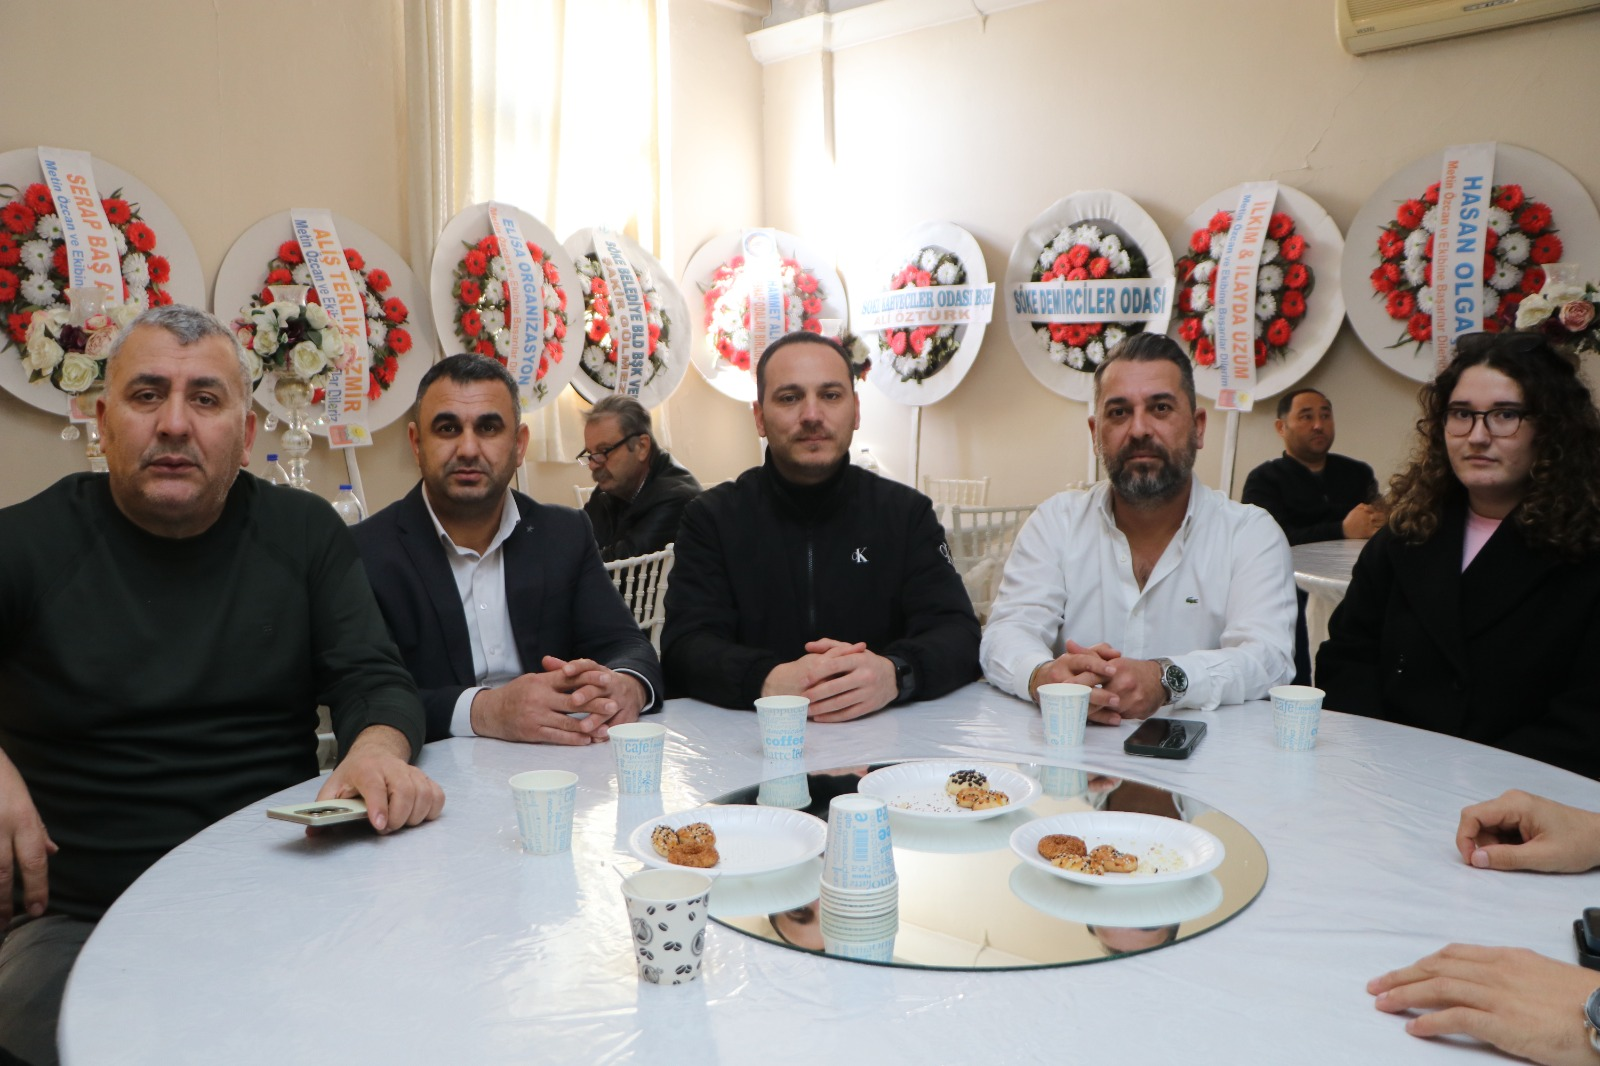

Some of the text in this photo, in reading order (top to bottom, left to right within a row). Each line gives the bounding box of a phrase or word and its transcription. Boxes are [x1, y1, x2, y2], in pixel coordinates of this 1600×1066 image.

[1447, 160, 1459, 189] Metin
[45, 160, 84, 288] Metin Özcan ve Ekibin
[67, 173, 103, 231] SERAP
[87, 234, 112, 275] BAŞ
[489, 206, 500, 234] Metin
[1237, 194, 1251, 222] Metin
[1441, 191, 1454, 225] Özcan
[498, 236, 510, 266] Özcan
[1226, 223, 1243, 256] Özcan
[1441, 228, 1448, 240] ve
[294, 219, 312, 248] Metin
[306, 248, 324, 282] Özcan
[319, 282, 329, 295] ve
[506, 267, 513, 279] ve
[1222, 256, 1229, 267] ve
[1437, 242, 1449, 283] Ekibine
[1451, 175, 1484, 344] HASAN OLGA
[313, 228, 341, 267] ALİŞ
[330, 268, 360, 337] TERLİK
[509, 280, 521, 315] Ekibine
[618, 267, 643, 322] BELEDİYE
[937, 289, 974, 308] ODASI
[1013, 281, 1167, 315] SÖKE DEMİRCİLER ODASI
[1219, 269, 1231, 306] Ekibine
[1231, 200, 1265, 379] İLKİM & İLAYDA ÜZÜM
[502, 218, 542, 386] ELİSA ORGANİZASYON
[754, 302, 766, 333] ODALARI
[895, 307, 971, 323] ÖZTÜRK
[1436, 284, 1448, 332] Başarılar
[631, 324, 645, 349] BLD
[1217, 308, 1227, 351] Başarılar
[617, 314, 632, 394] GÜLMEZ
[629, 352, 645, 376] BŞK
